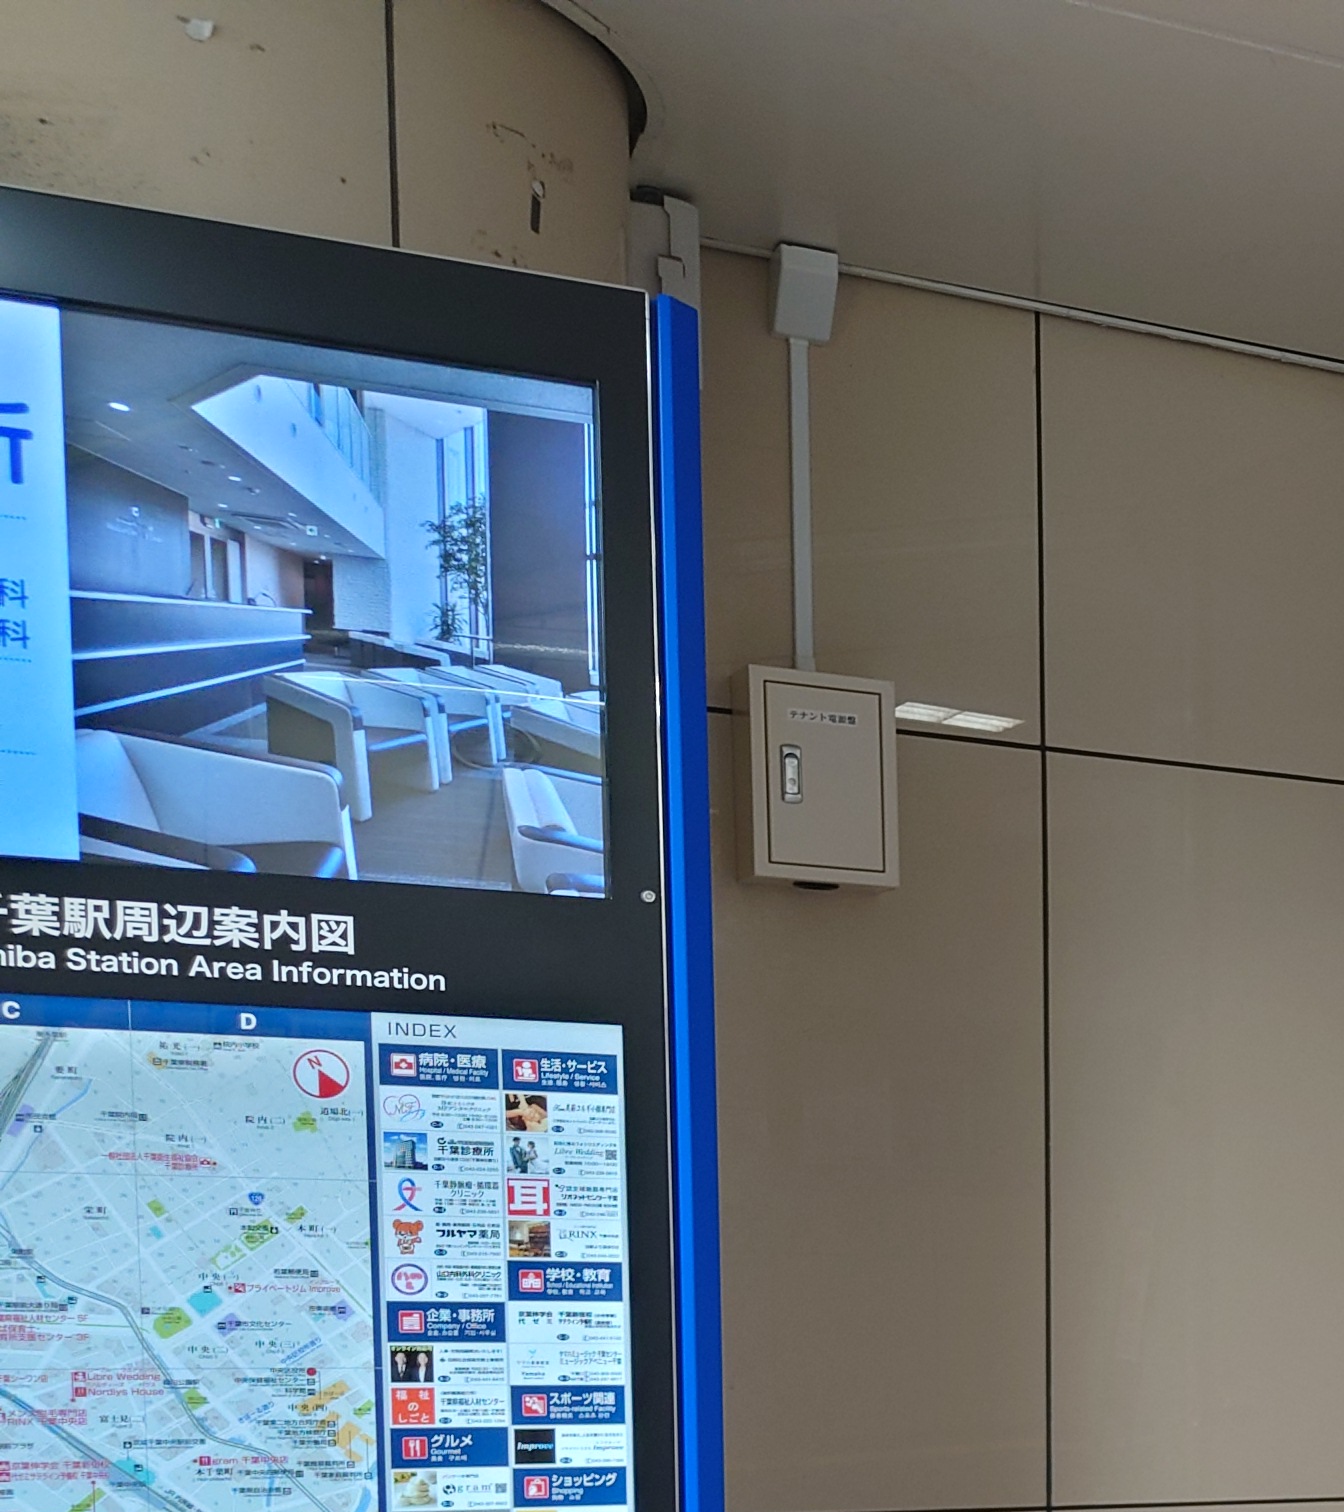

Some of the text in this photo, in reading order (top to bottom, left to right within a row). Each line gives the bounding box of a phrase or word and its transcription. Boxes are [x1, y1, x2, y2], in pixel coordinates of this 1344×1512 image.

[0, 892, 355, 955] 葉駅周辺案内図
[67, 947, 447, 992] Station Area Information
[2, 1001, 20, 1018] C
[240, 1014, 257, 1030] D
[388, 1022, 457, 1038] INDEX
[307, 1055, 322, 1070] N
[419, 1053, 487, 1069] 病院・医療
[540, 1058, 608, 1074] 生活・サービス
[438, 1145, 494, 1157] 千葉診療所
[450, 1190, 485, 1198] クリニック
[436, 1229, 501, 1239] フルヤマ薬局
[546, 1268, 611, 1282] 学校・教育
[426, 1309, 495, 1322] 企業・事務所
[395, 1390, 430, 1400] 福祉
[550, 1392, 615, 1405] スポーツ関連
[408, 1402, 419, 1411] の
[399, 1413, 430, 1423] しごと
[431, 1434, 473, 1448] グルメ
[517, 1442, 554, 1451] Improve
[551, 1472, 617, 1487] ショッピング
